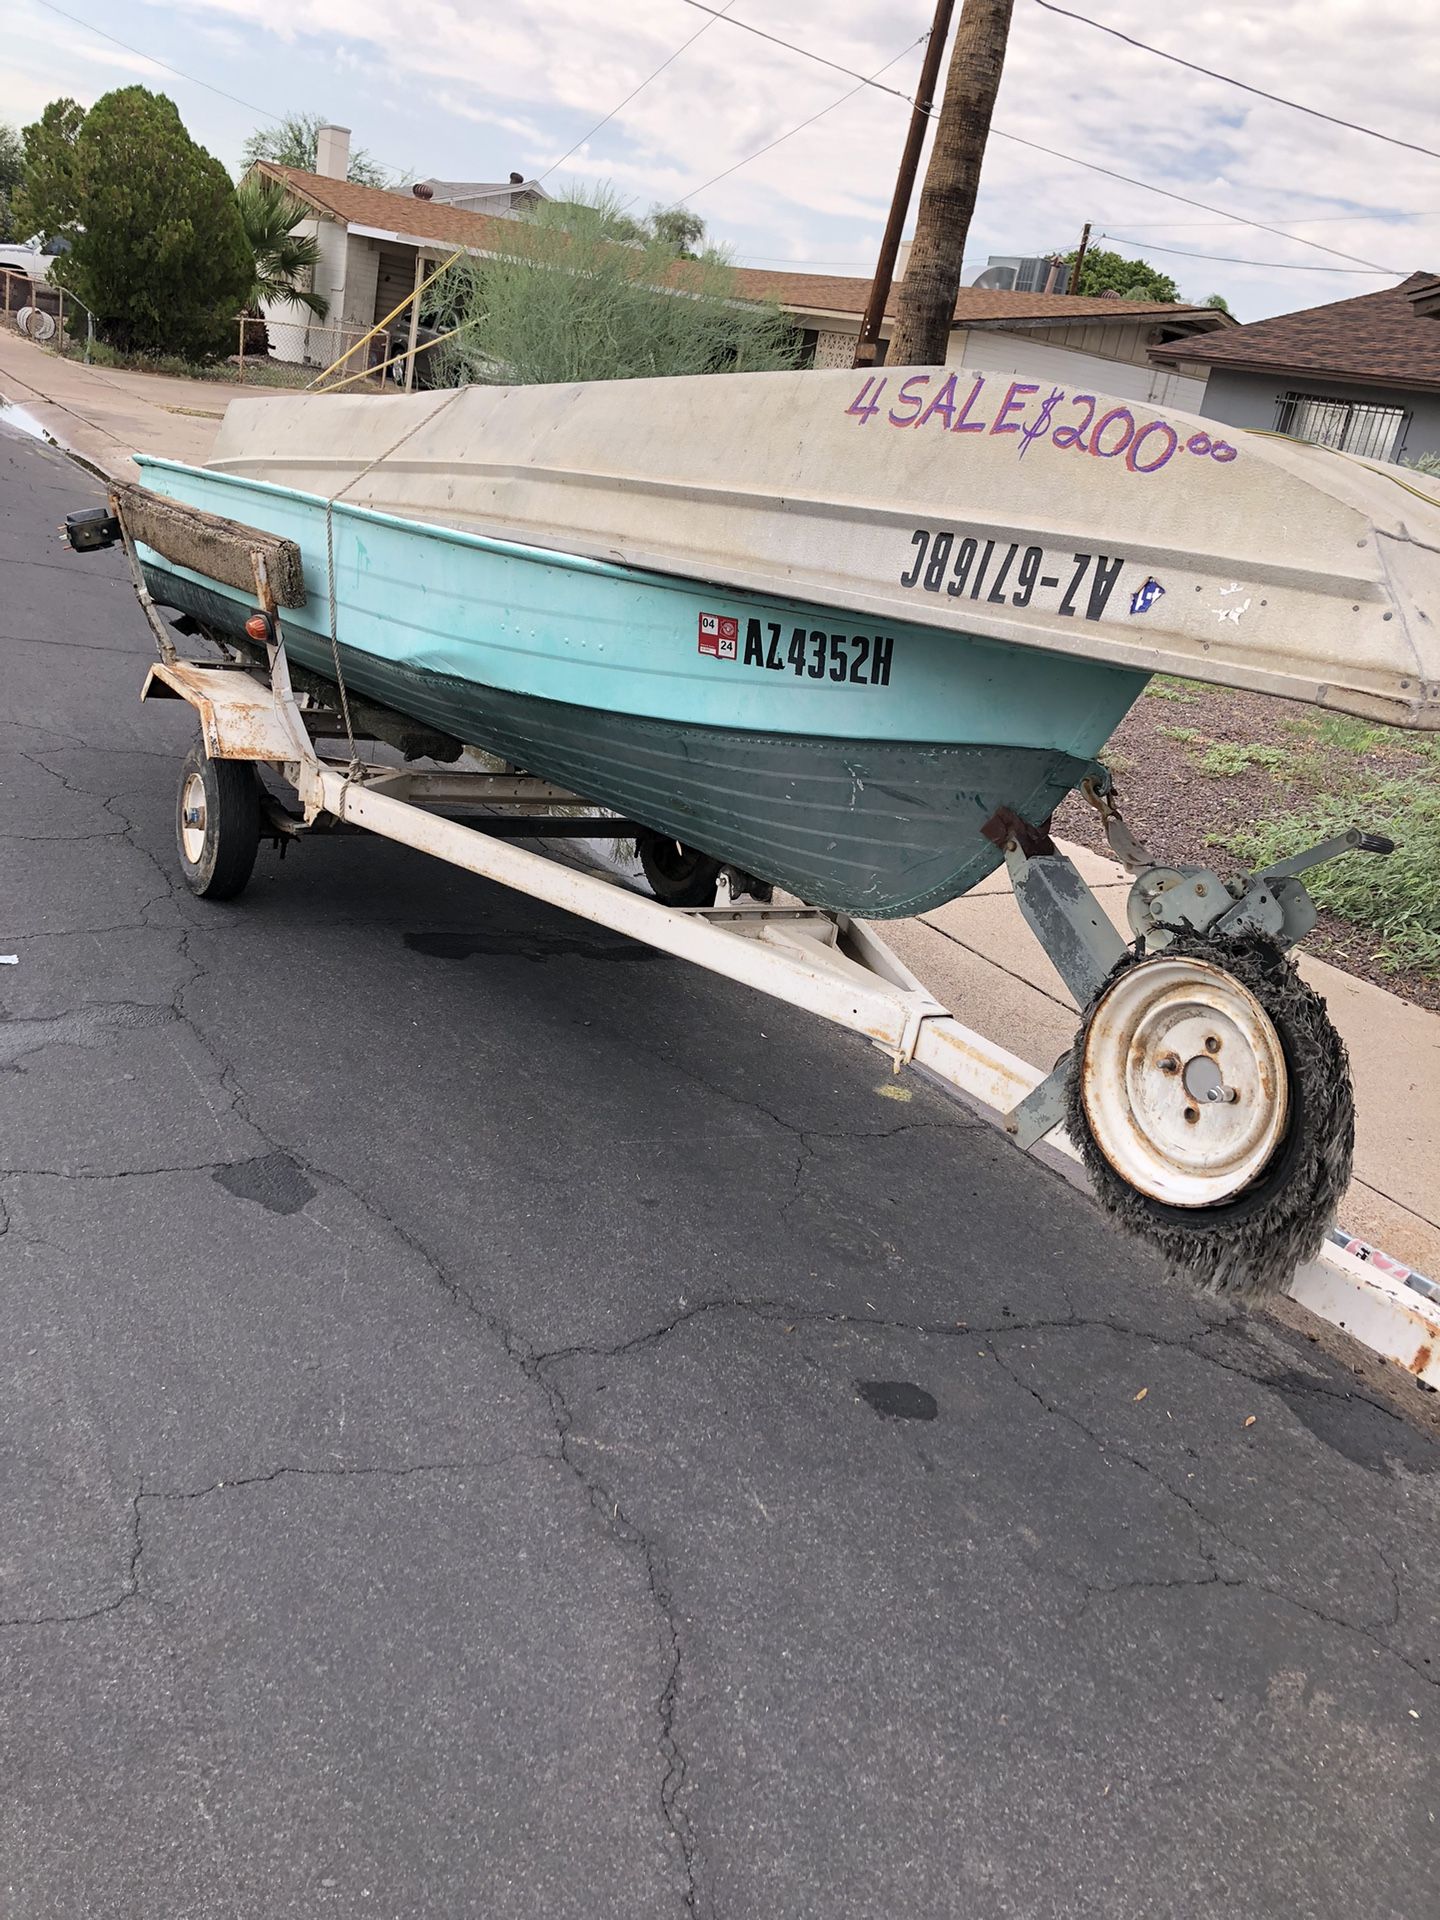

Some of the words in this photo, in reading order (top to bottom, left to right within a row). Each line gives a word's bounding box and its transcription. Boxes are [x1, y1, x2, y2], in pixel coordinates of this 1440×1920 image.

[844, 376, 888, 426] 4
[888, 372, 1041, 436] SALE
[900, 529, 1125, 622] AZ-6716BC
[702, 617, 715, 629] 04
[720, 640, 733, 652] 24
[743, 618, 895, 686] AZ4352H
